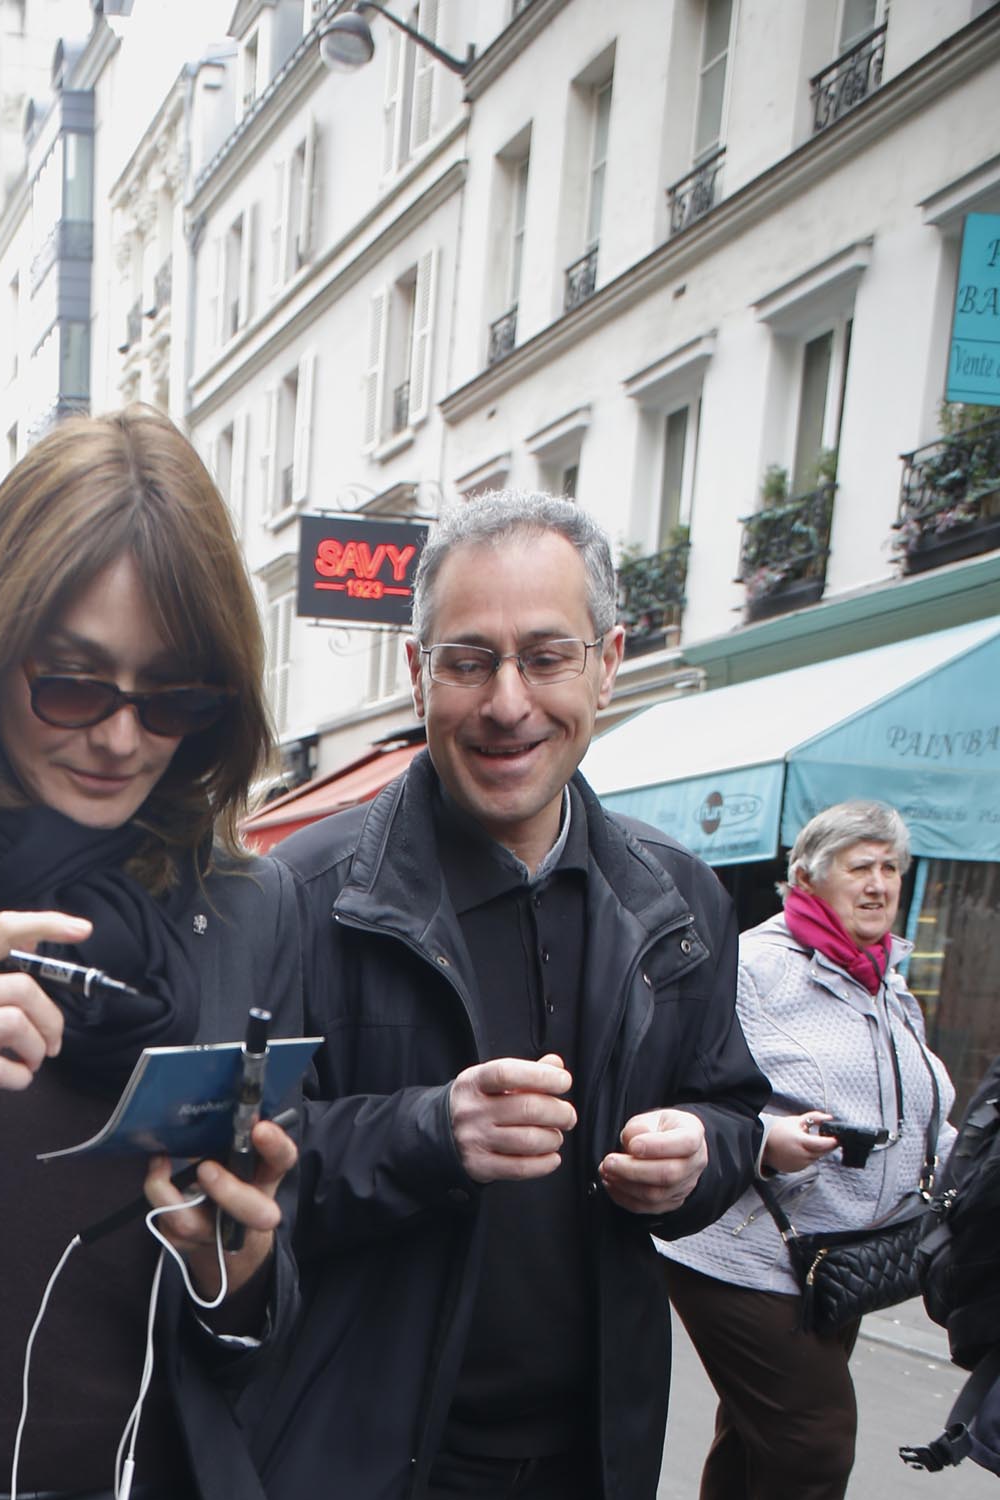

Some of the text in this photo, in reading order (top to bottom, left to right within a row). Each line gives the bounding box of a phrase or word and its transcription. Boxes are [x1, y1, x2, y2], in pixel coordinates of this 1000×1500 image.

[953, 343, 992, 378] Vente
[313, 537, 417, 582] SAVY
[887, 725, 963, 759] PAIN
